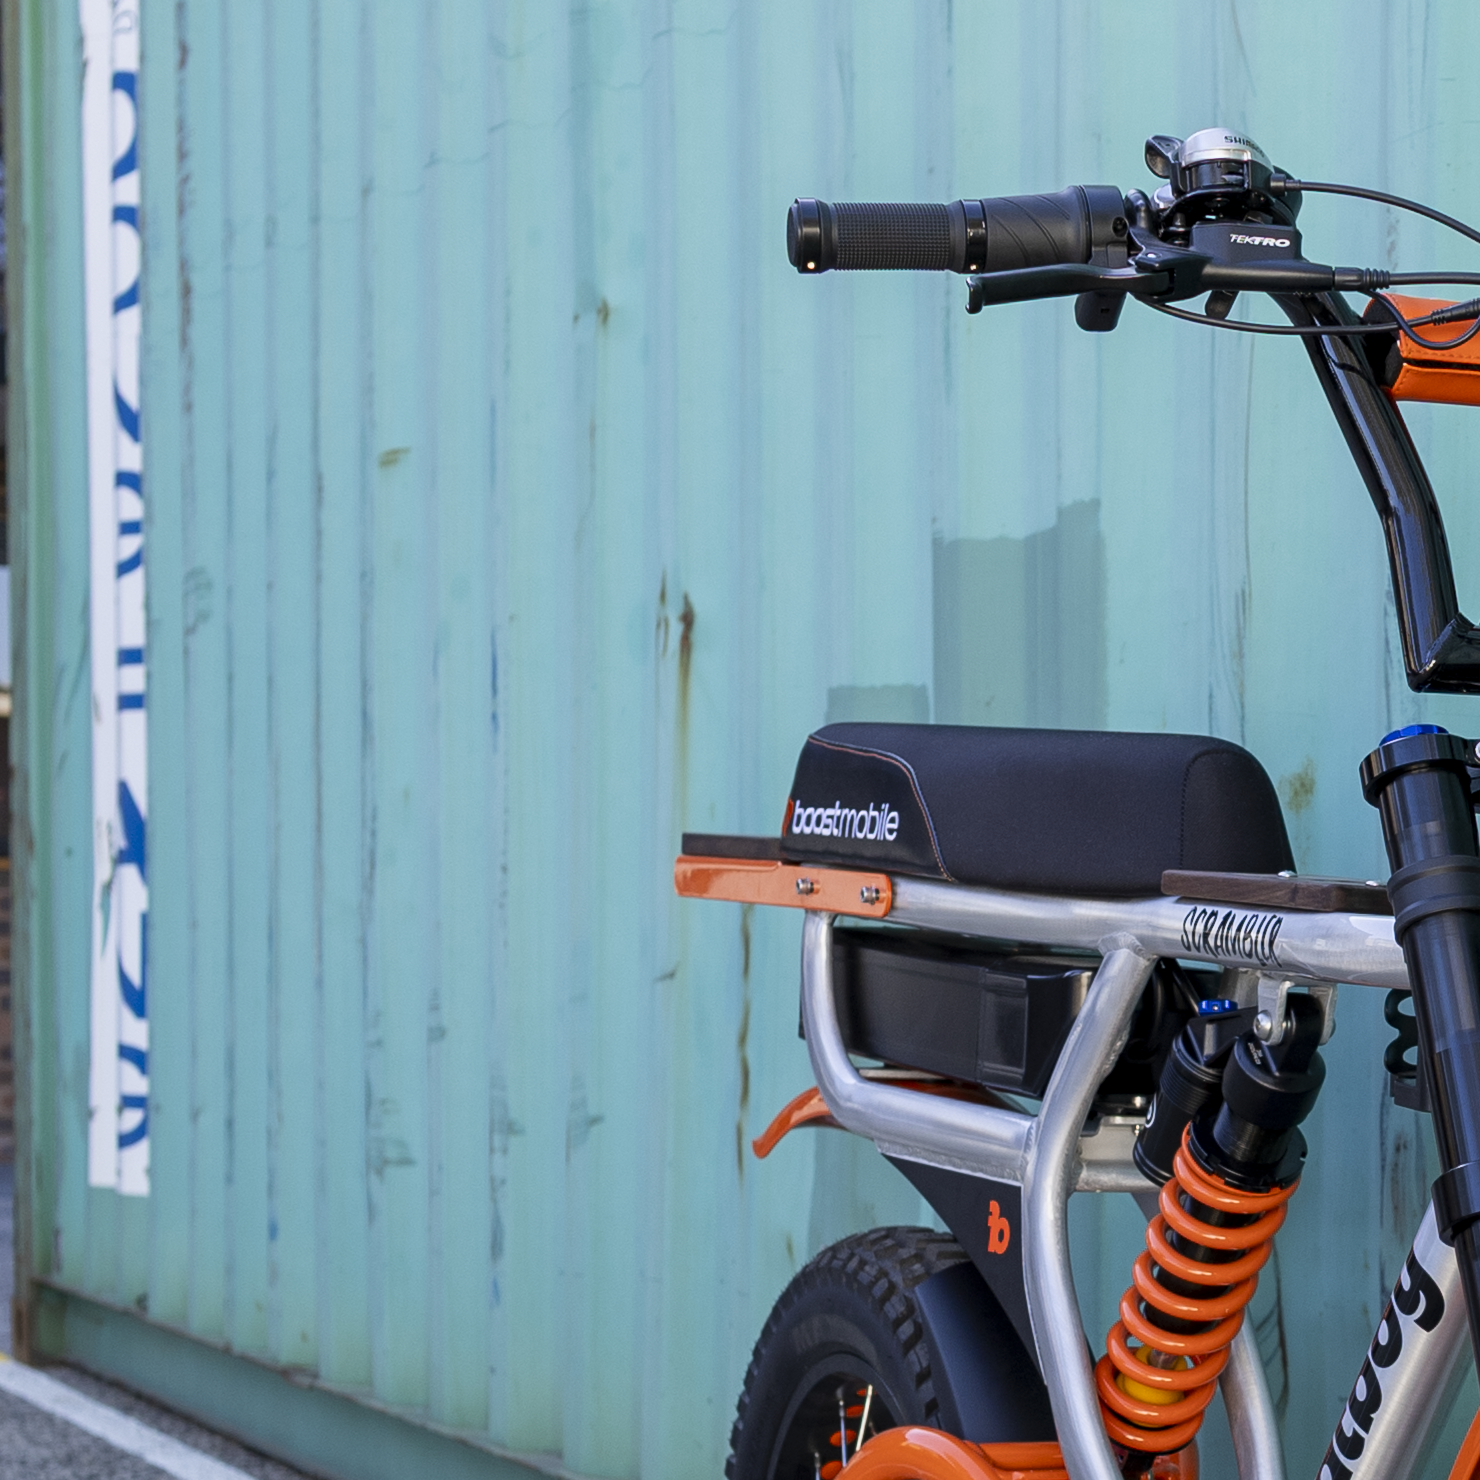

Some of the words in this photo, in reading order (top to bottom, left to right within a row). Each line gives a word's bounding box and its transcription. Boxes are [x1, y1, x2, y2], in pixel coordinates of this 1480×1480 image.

[1229, 233, 1291, 248] TEKTRO
[791, 799, 900, 841] boostmobile
[1180, 905, 1284, 968] SCRAMBLER
